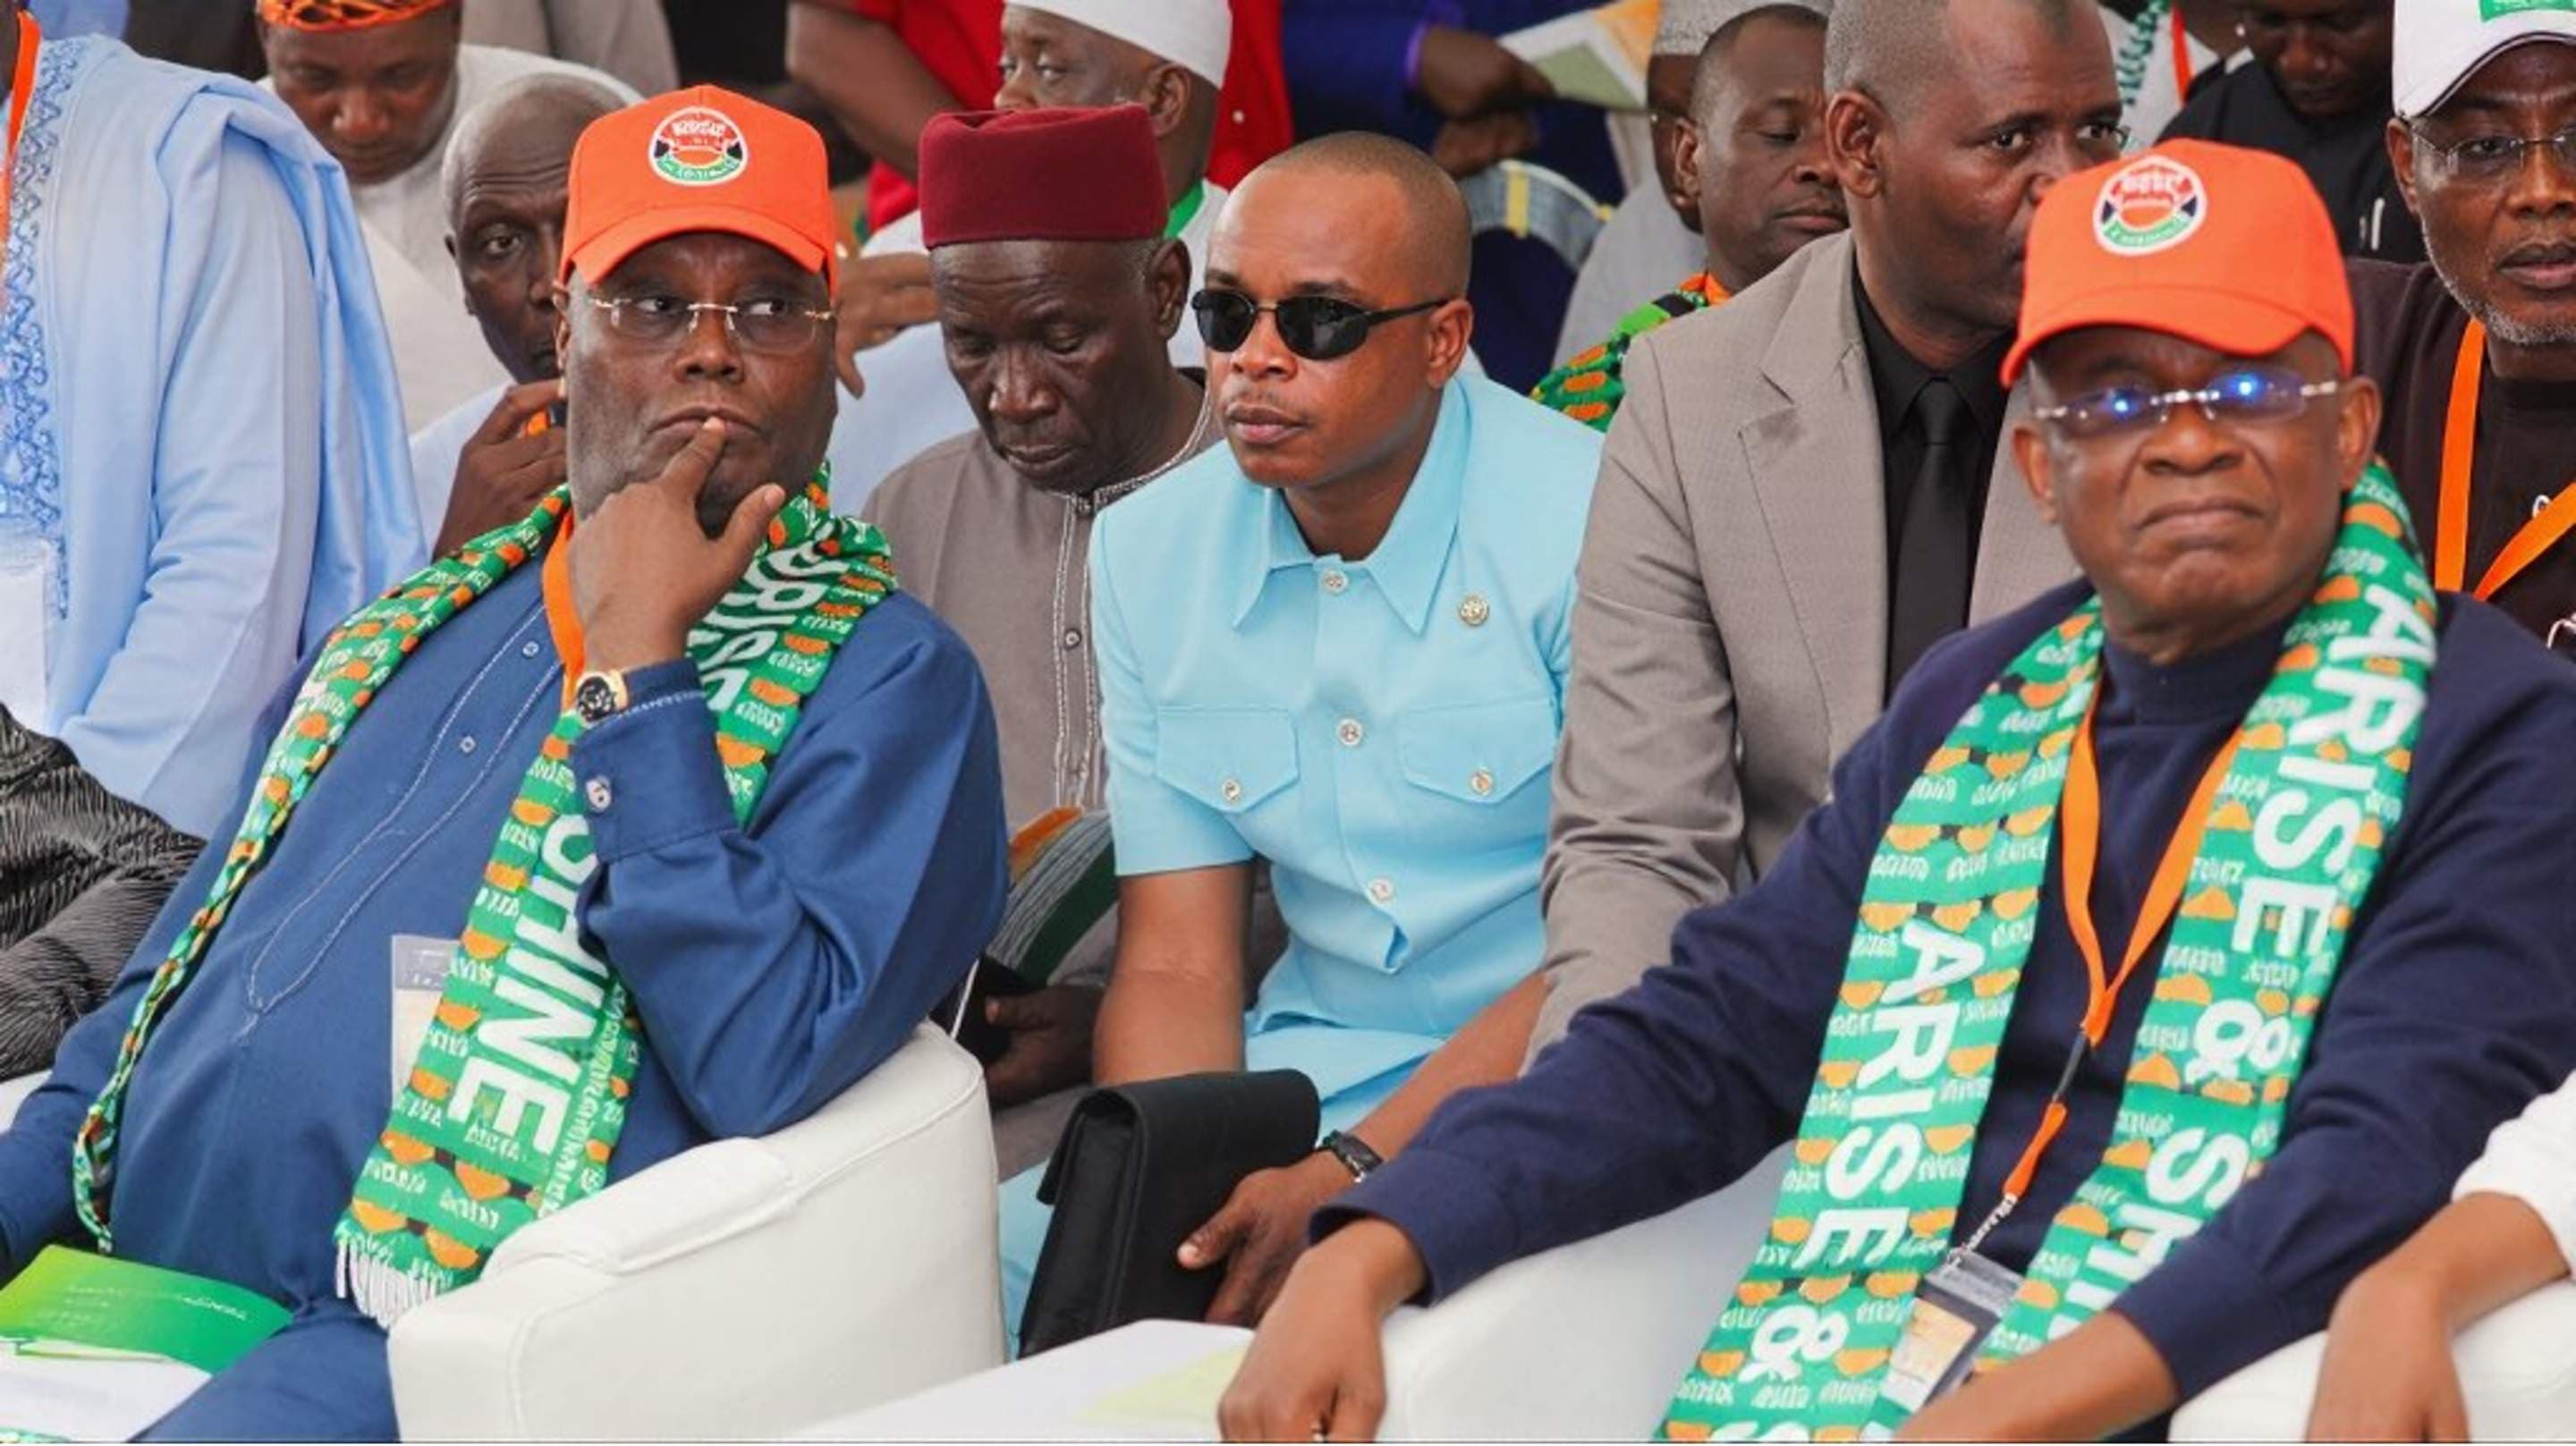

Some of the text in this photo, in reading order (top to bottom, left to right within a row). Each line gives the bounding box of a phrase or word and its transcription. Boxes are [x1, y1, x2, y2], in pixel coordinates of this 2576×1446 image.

[2232, 583, 2438, 955] ARISE
[1791, 918, 1986, 1269] ARISE
[2184, 997, 2292, 1084] &
[1737, 1304, 1851, 1383] &
